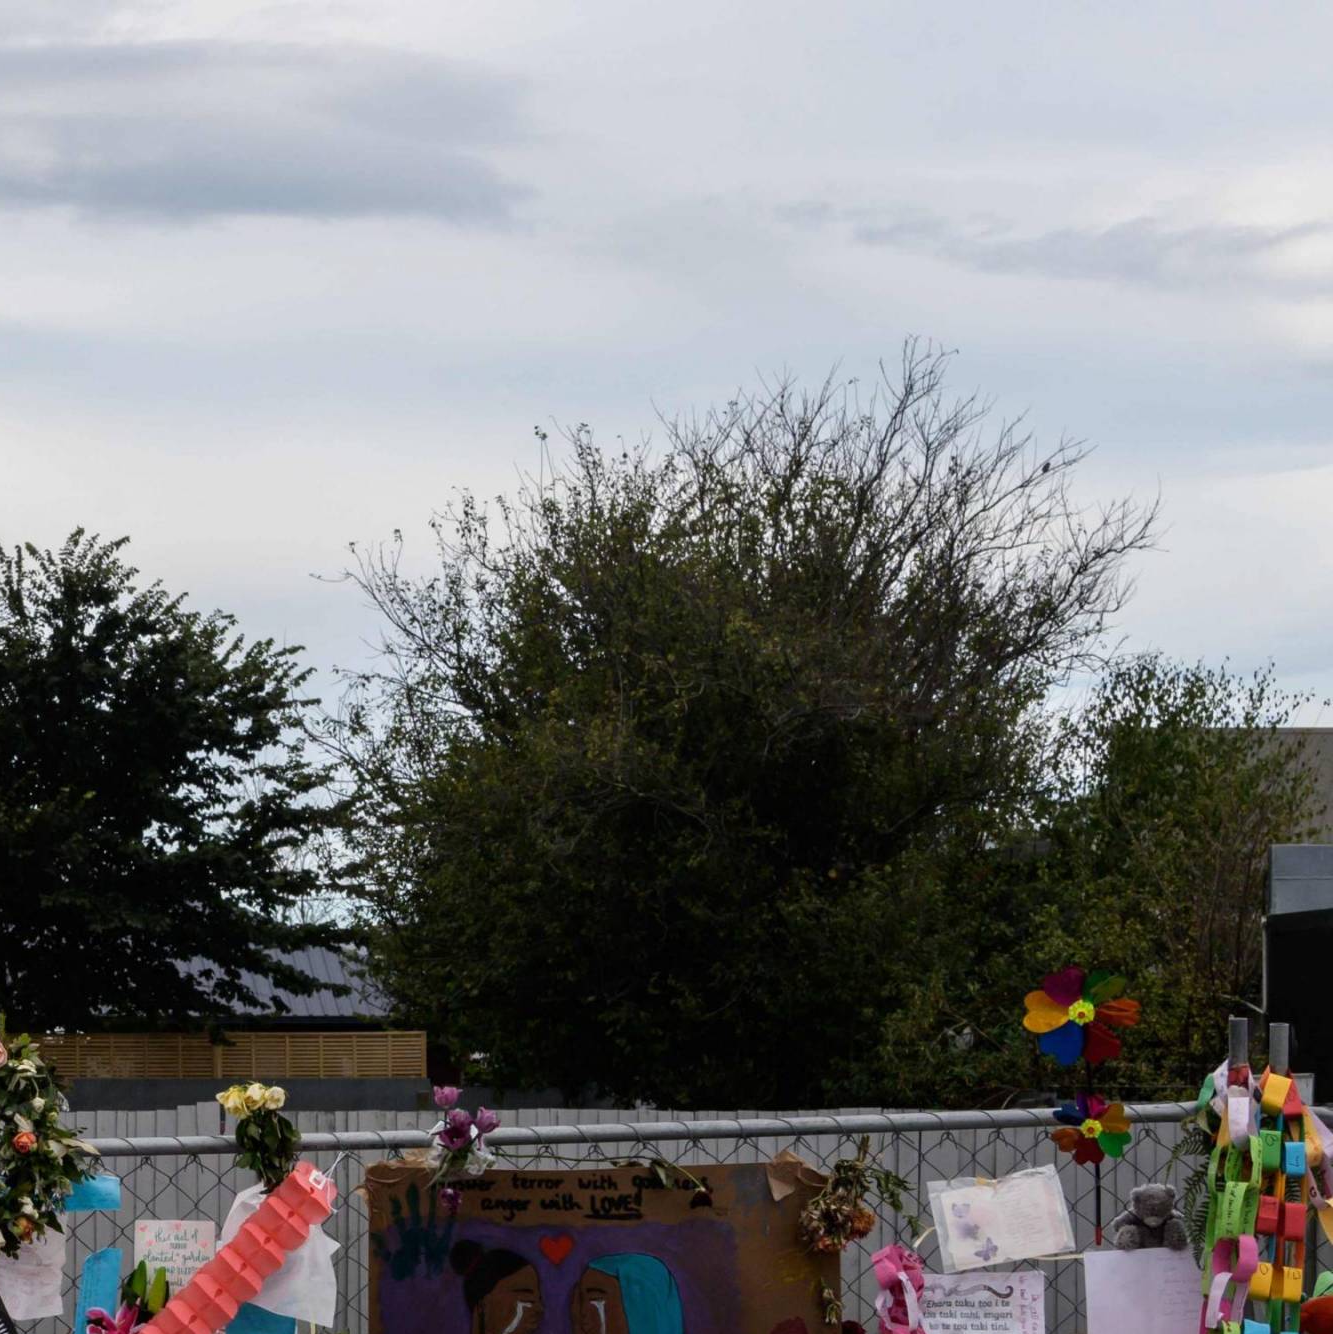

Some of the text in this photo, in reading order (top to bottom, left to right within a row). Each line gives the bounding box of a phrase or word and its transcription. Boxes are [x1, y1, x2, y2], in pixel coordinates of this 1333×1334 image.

[511, 1175, 619, 1190] terror with
[481, 1192, 643, 1221] anger with LOVE!
